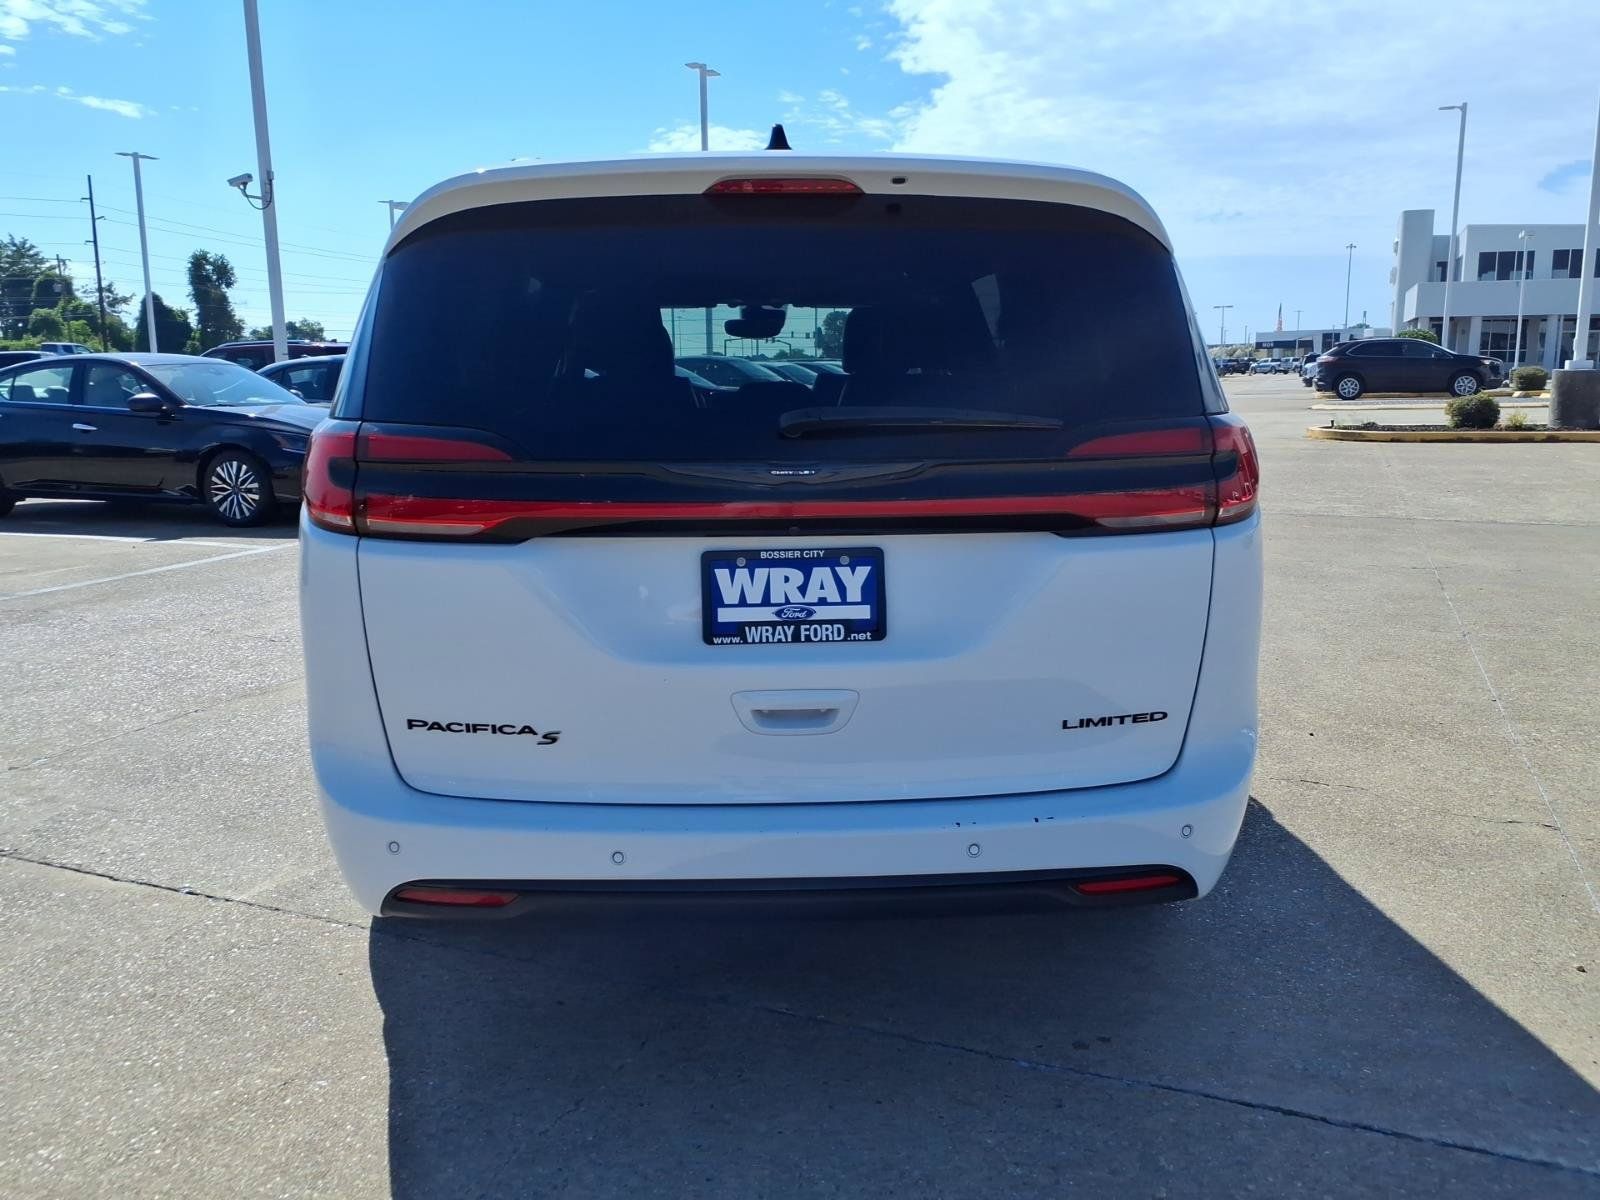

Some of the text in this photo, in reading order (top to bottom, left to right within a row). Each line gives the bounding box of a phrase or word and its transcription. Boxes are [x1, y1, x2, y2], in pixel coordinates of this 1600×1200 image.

[760, 550, 825, 559] BOSSIER CITY
[714, 566, 872, 604] WRAY
[781, 607, 808, 618] Ford
[744, 625, 795, 643] WRAY
[800, 624, 845, 641] FORD
[1062, 711, 1168, 729] LIMITED
[406, 719, 562, 745] PACIFICA S
